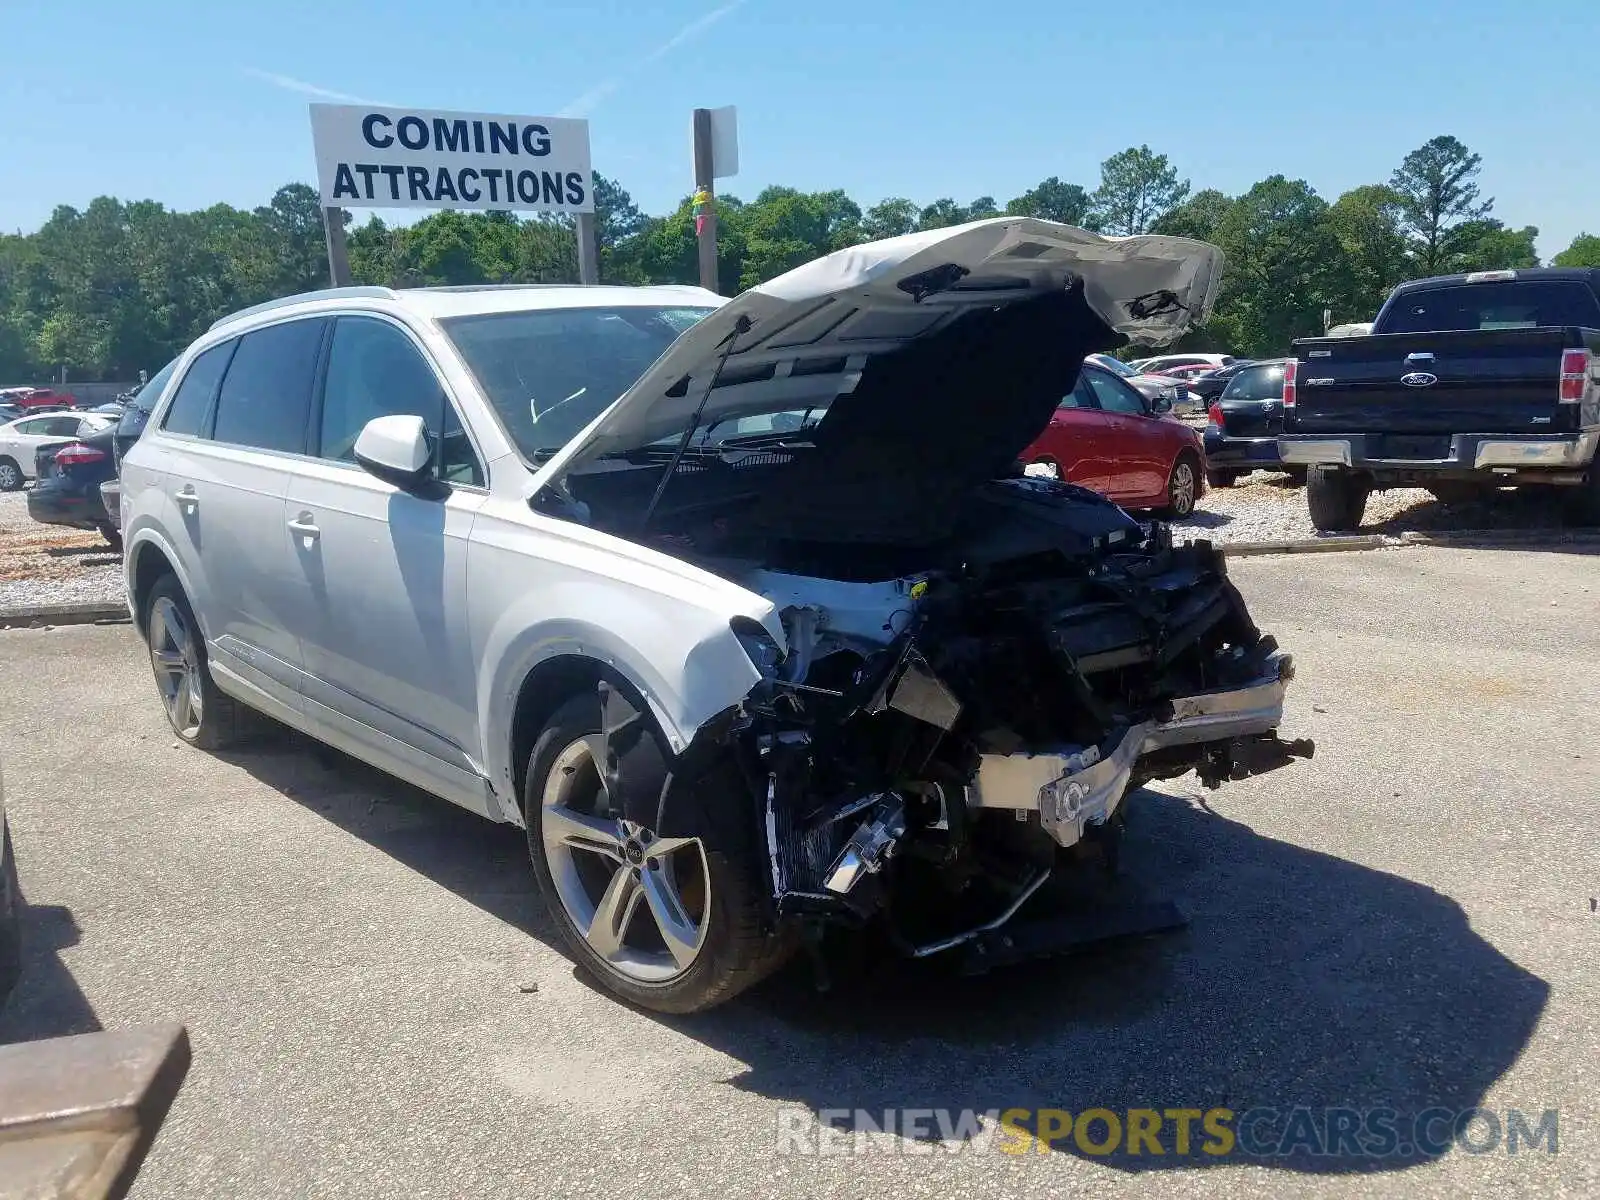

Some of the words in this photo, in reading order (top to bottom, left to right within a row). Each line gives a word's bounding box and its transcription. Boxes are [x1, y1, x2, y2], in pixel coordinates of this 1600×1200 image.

[362, 113, 552, 157] COMING
[333, 163, 585, 205] ATTRACTIONS
[1405, 374, 1432, 385] Ford
